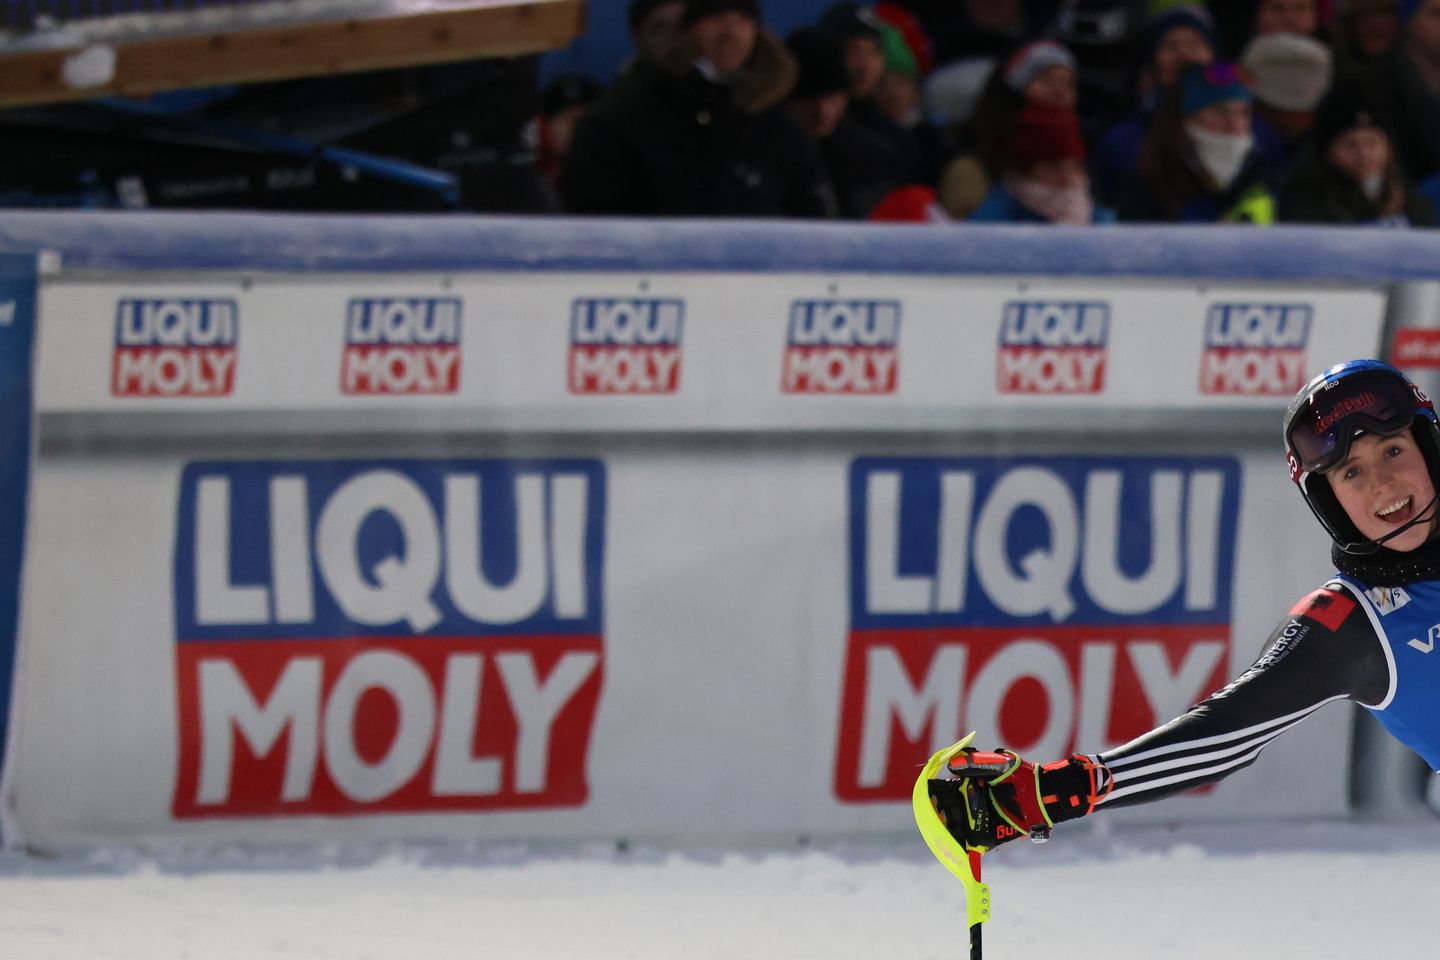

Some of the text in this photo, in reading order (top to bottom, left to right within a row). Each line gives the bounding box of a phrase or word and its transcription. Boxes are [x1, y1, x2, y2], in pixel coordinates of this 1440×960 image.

[119, 301, 237, 345] LIQUI
[351, 301, 458, 344] LIQUI
[577, 302, 679, 344] LIQUI
[795, 302, 897, 345] LIQUI
[1007, 304, 1104, 346] LIQUI
[1210, 306, 1307, 347] LIQUI
[116, 350, 235, 393] MOLY
[349, 350, 460, 393] MOLY
[573, 350, 679, 392] MOLY
[790, 350, 896, 392] MOLY
[1003, 349, 1104, 393] MOLY
[1205, 350, 1305, 393] MOLY
[195, 469, 590, 634] LIQUI
[865, 465, 1225, 624] LIQUI
[195, 650, 601, 805] MOLY
[857, 638, 1228, 789] MOLY
[975, 809, 984, 832] LEKI
